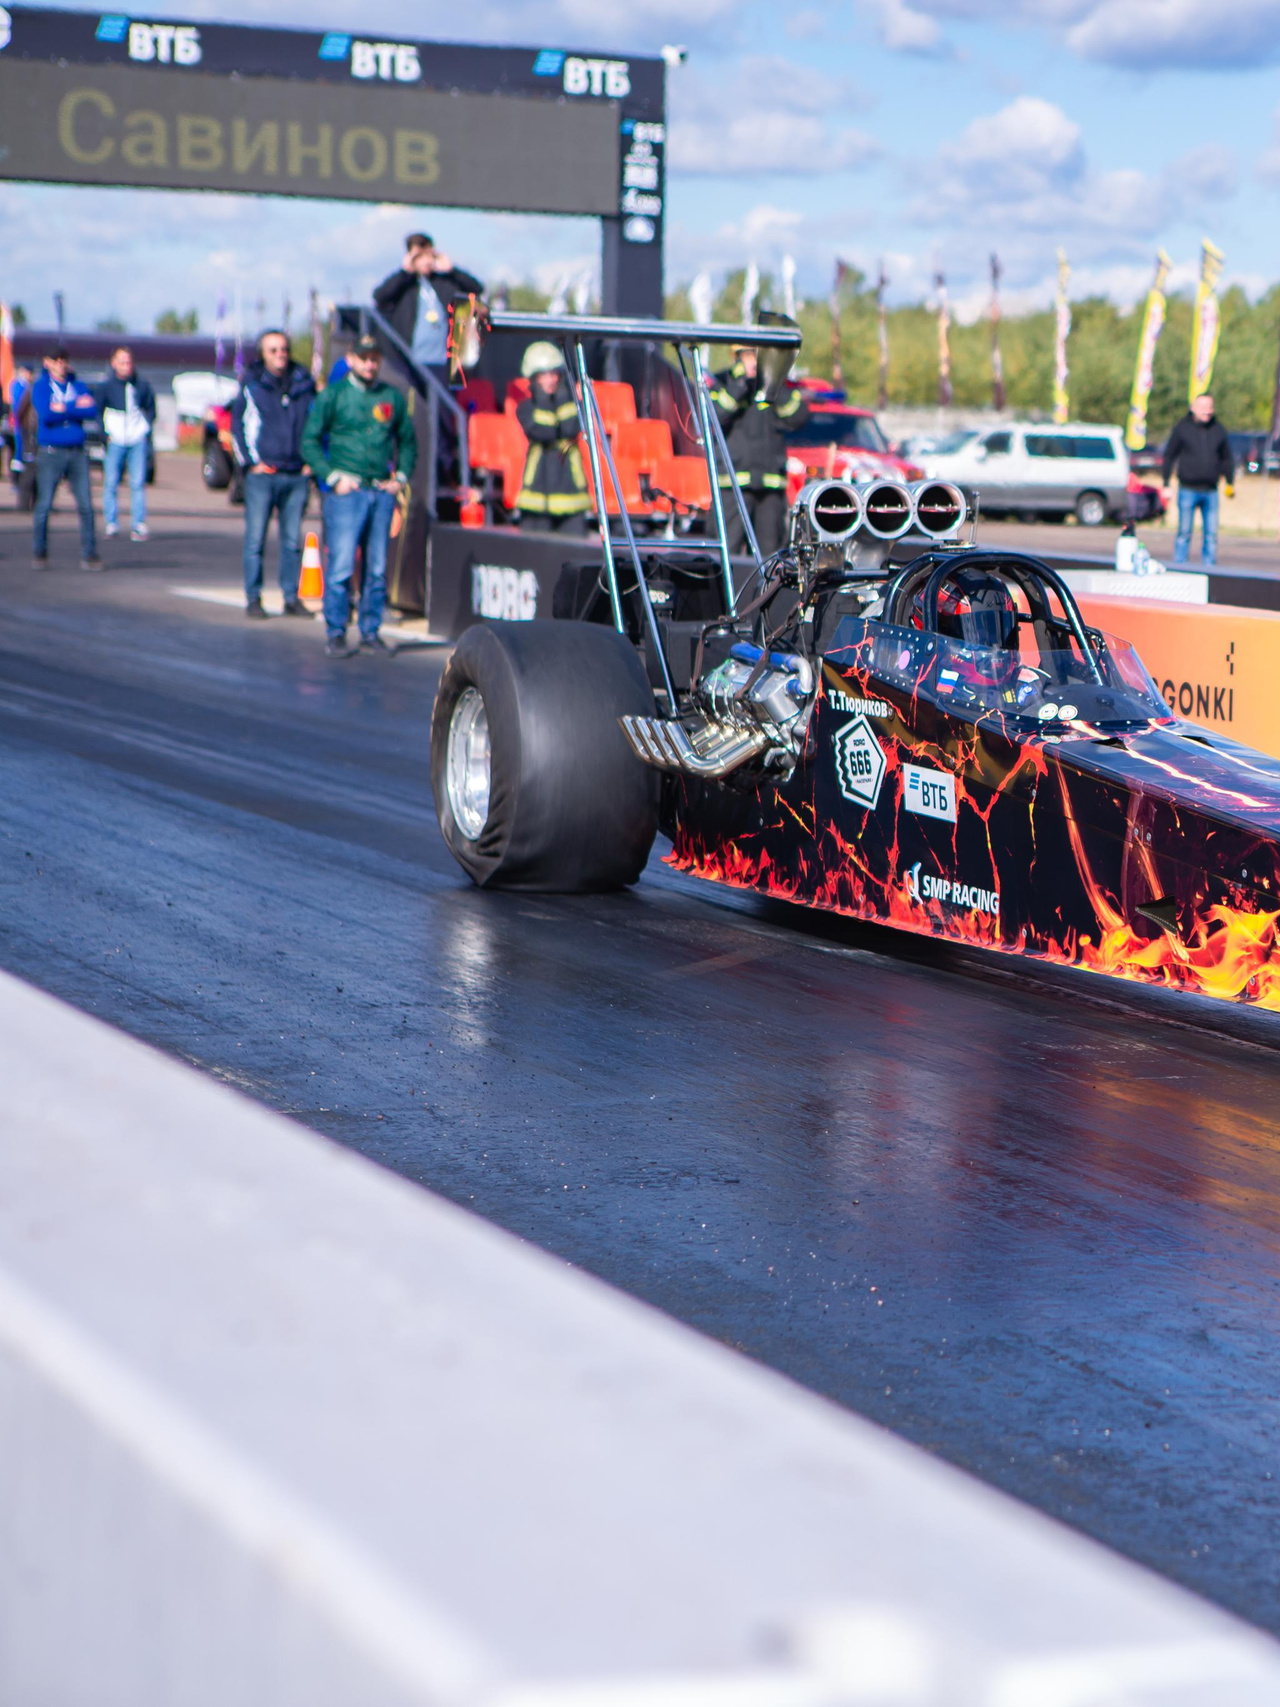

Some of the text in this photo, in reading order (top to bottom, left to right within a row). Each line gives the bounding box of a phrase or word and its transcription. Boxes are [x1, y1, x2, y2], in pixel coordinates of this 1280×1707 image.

[129, 22, 201, 65] ВТБ
[351, 42, 421, 82] ВТБ
[563, 57, 630, 98] ВТБ
[58, 87, 440, 186] Савинов
[1152, 677, 1234, 722] GONKI
[849, 749, 872, 776] 666
[921, 781, 948, 811] ВТБ
[922, 874, 1000, 914] SMP RACING
